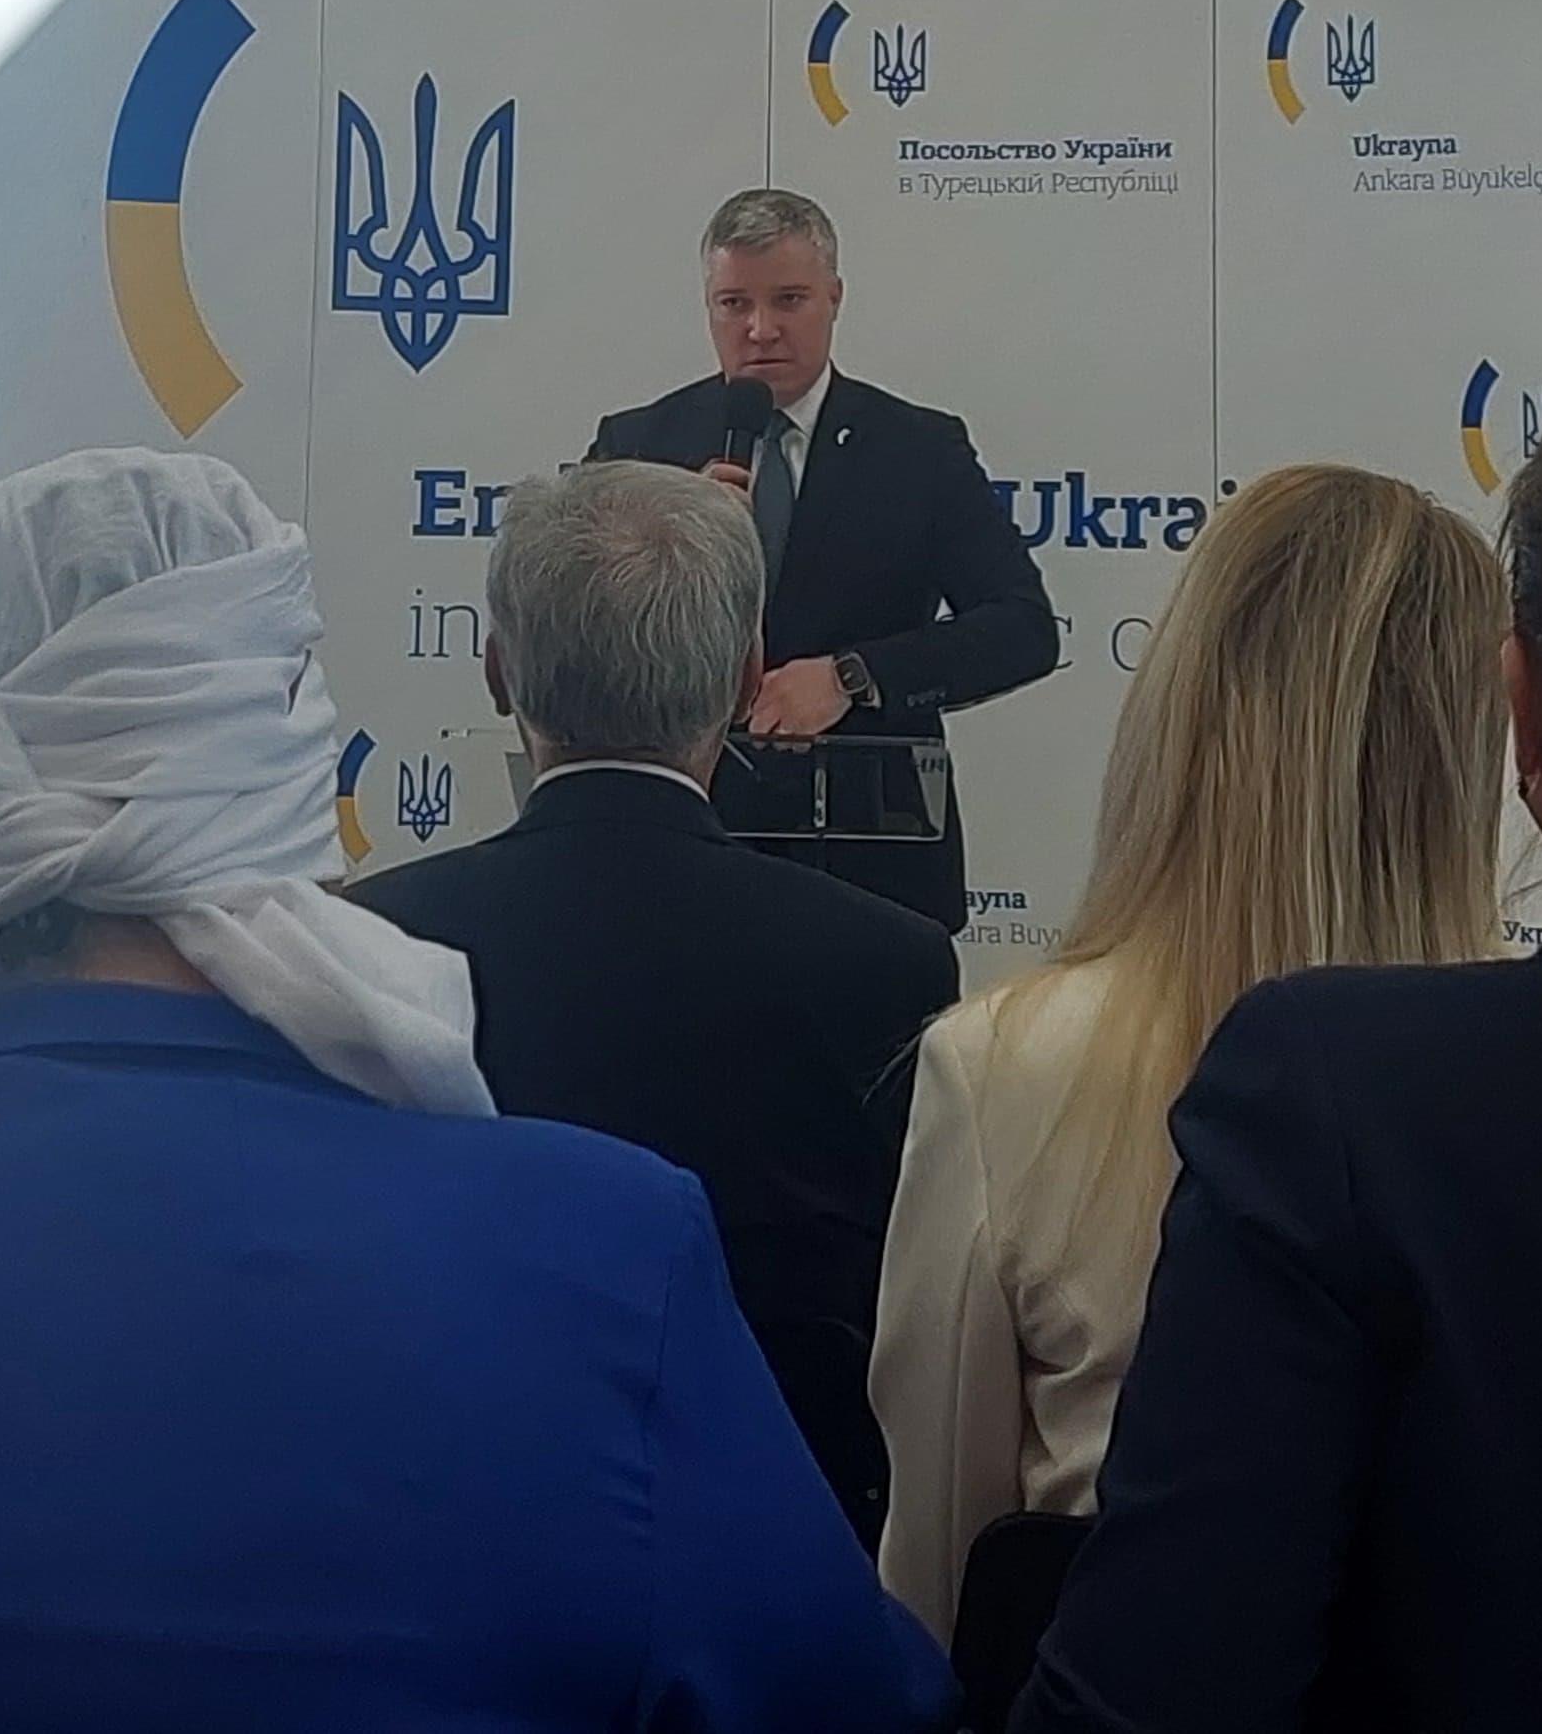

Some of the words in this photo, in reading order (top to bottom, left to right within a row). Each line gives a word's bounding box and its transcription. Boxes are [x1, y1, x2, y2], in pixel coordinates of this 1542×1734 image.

[899, 139, 1057, 161] Посольство
[1063, 137, 1173, 165] України
[1352, 133, 1458, 162] Ukrayna
[899, 176, 913, 194] в
[919, 172, 1044, 201] Турецькій
[1051, 168, 1180, 200] Республіці
[1353, 167, 1435, 193] Ankara
[407, 587, 484, 659] in
